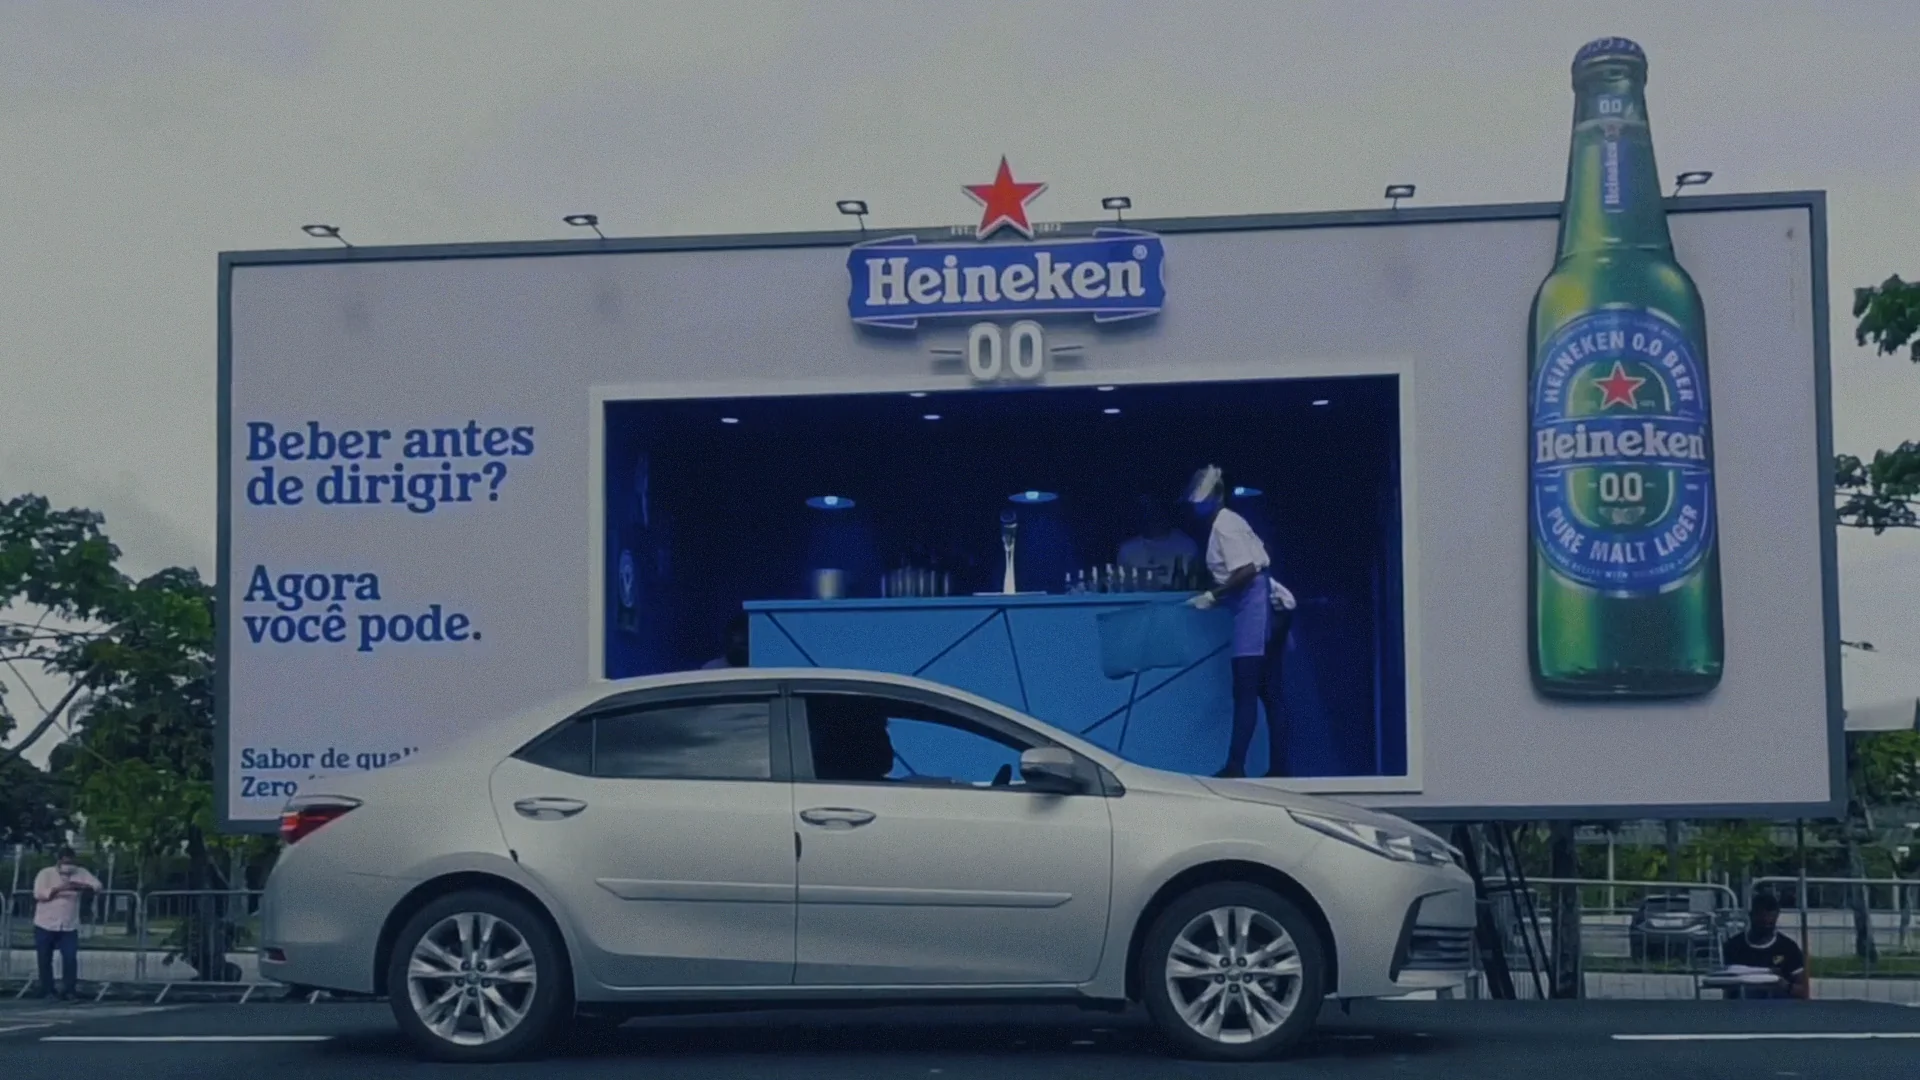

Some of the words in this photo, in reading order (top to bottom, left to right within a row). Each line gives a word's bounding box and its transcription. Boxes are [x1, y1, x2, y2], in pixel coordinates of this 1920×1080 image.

[1543, 332, 1625, 404] HEINEKEN
[1632, 332, 1663, 357] 0.0
[1662, 352, 1695, 402] BEER
[246, 421, 391, 461] Beber
[402, 420, 535, 458] antes
[1536, 422, 1706, 464] Heineken
[247, 466, 304, 506] de
[317, 461, 508, 514] dirigir?
[1547, 504, 1586, 554] PURE
[1589, 541, 1646, 564] MALT
[1654, 503, 1699, 558] LAGER
[243, 564, 381, 611] Agora
[243, 603, 346, 644] você
[357, 605, 482, 652] pode.
[241, 747, 316, 770] Sabor
[321, 747, 350, 769] de
[241, 776, 298, 798] Zero
